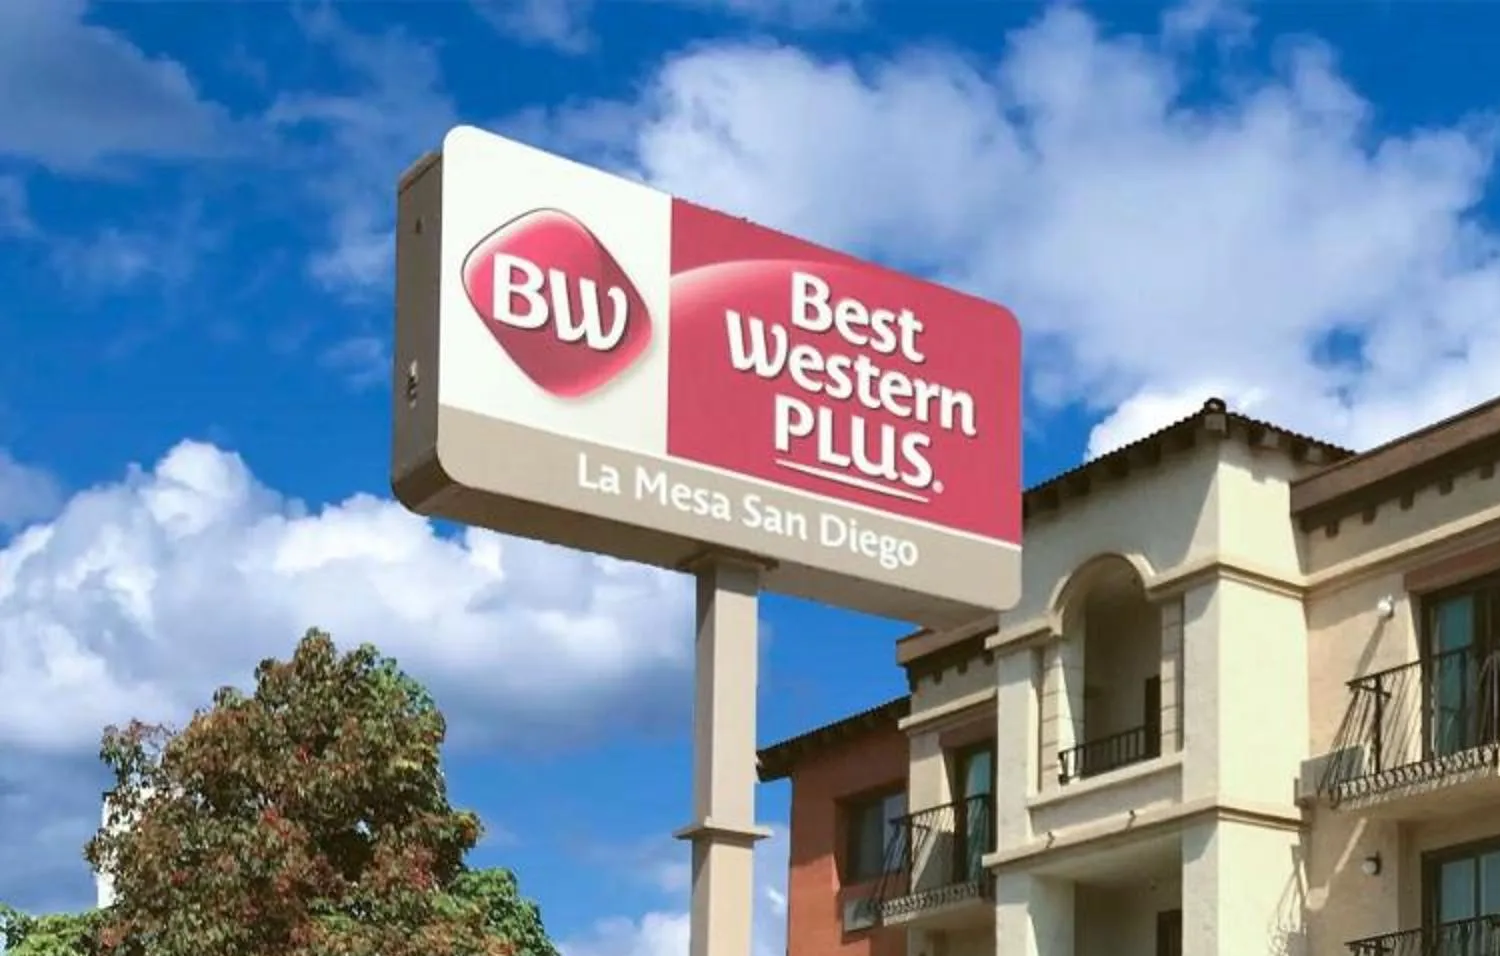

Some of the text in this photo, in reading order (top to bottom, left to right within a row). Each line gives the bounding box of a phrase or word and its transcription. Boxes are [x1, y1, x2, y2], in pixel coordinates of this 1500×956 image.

[492, 253, 629, 352] BW
[790, 271, 926, 363] Best
[725, 308, 977, 436] Western
[577, 453, 919, 570] La Mesa San Diego
